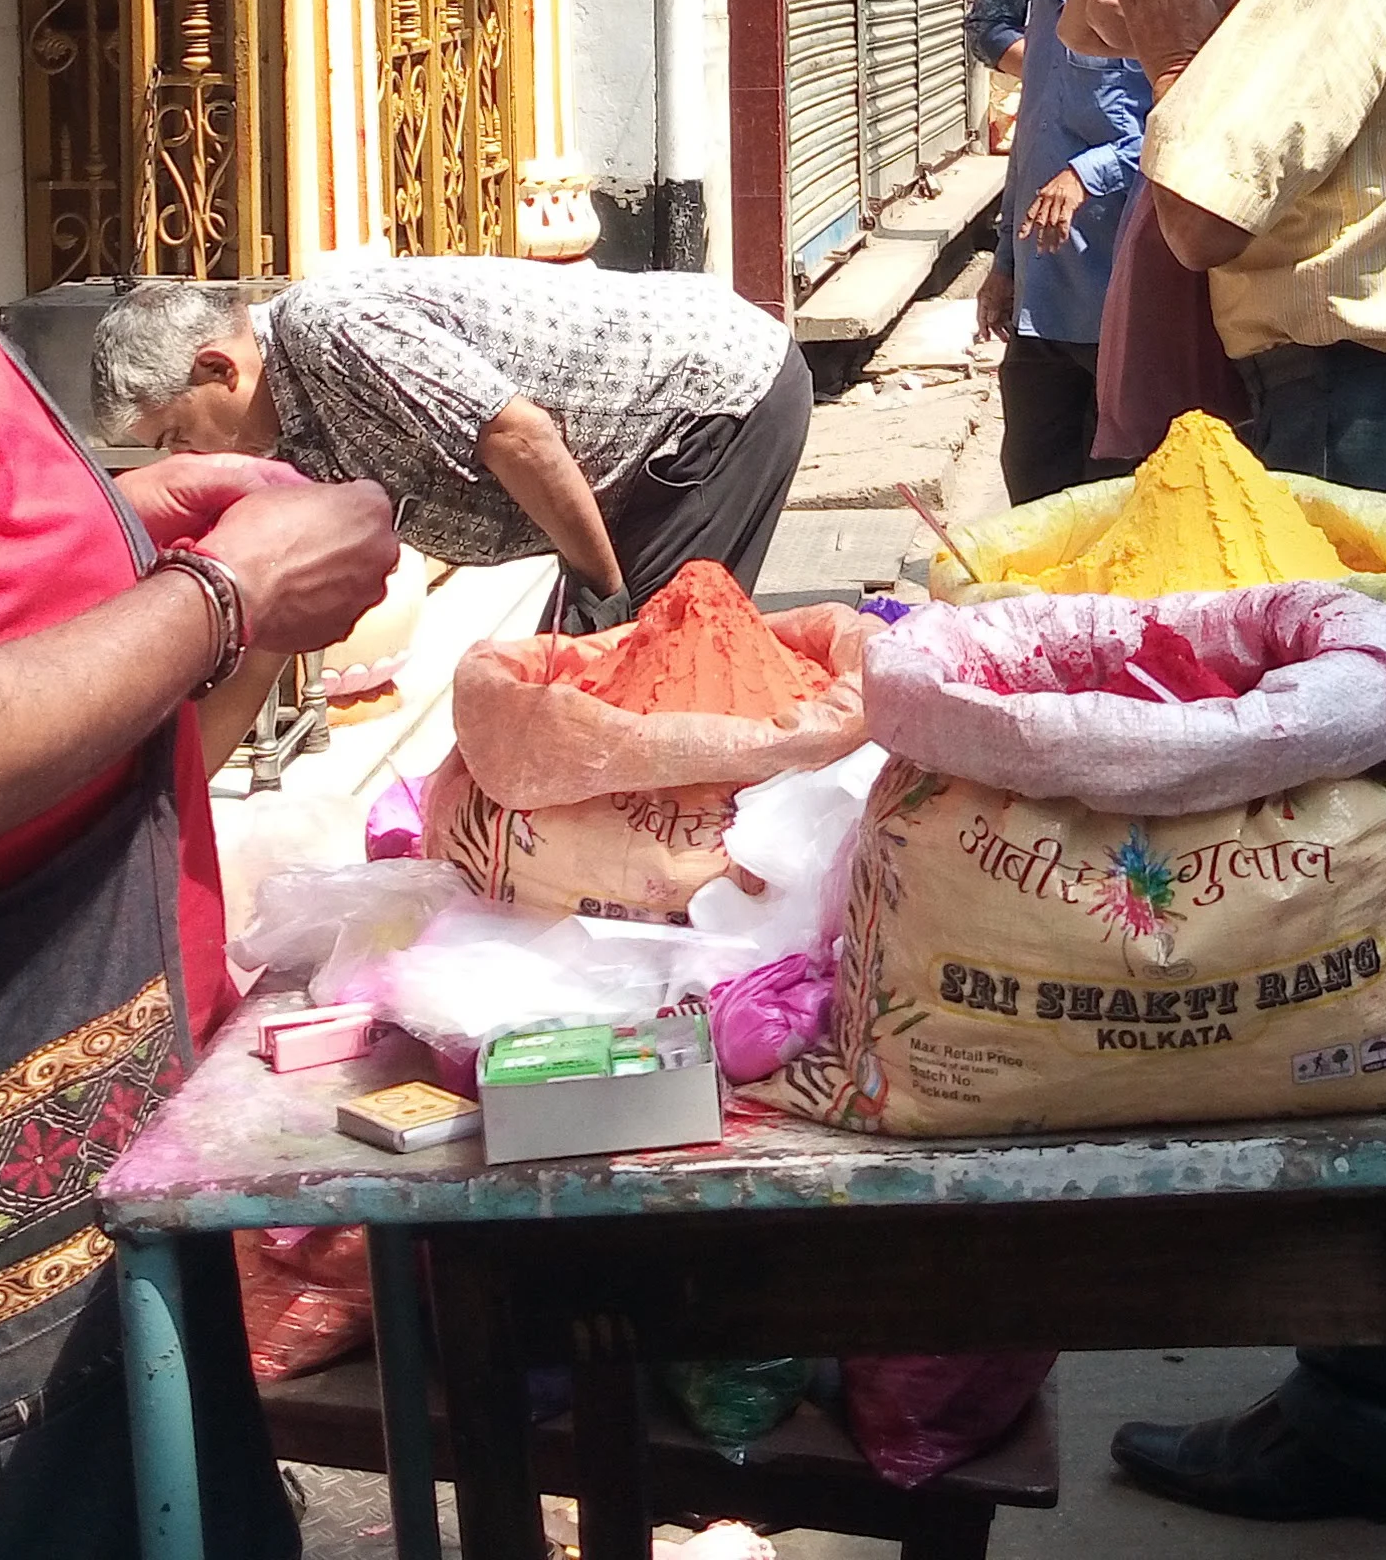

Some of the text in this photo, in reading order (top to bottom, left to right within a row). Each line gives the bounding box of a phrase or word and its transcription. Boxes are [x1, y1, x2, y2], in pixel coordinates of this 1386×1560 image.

[1175, 839, 1336, 907] गुलाल
[940, 937, 1382, 1023] SRI SHAKTI RANG
[1096, 1022, 1234, 1050] KOLKATA
[944, 1045, 983, 1062] Retail
[986, 1051, 1024, 1067] Price
[909, 1064, 976, 1087] Batch No.
[912, 1079, 981, 1103] Packed on
